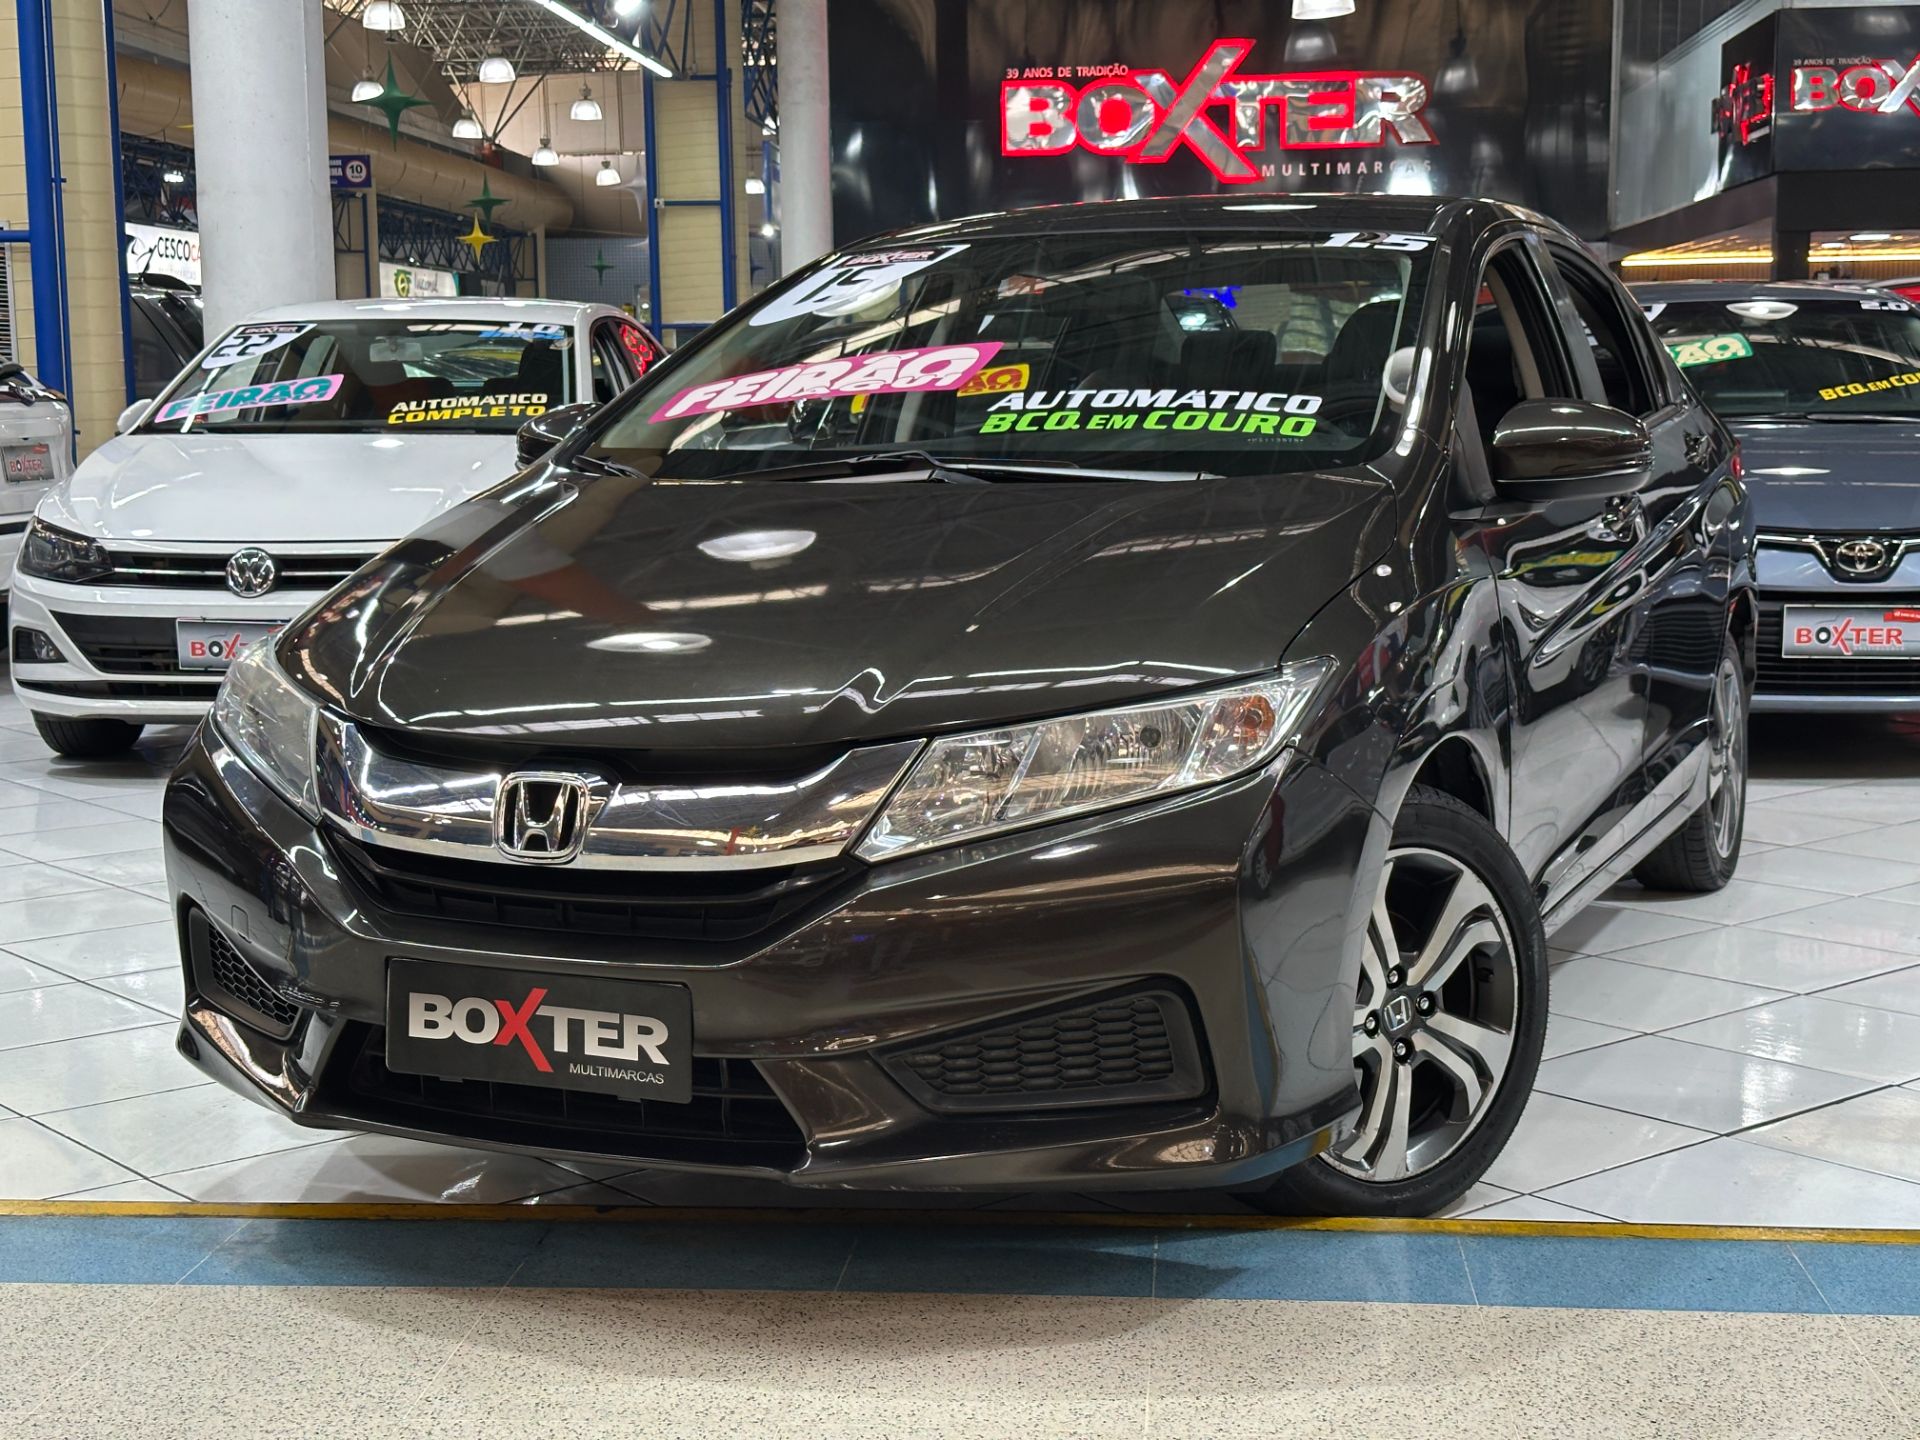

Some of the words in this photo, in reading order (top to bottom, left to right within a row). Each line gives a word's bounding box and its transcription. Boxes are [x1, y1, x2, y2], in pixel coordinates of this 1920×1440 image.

[1006, 68, 1019, 79] 39
[1023, 66, 1053, 78] ANOS
[1058, 66, 1072, 78] DE
[1076, 63, 1128, 78] TRADIÇÃO
[1002, 38, 1440, 184] BOXTER
[349, 164, 363, 175] 10
[1261, 159, 1433, 178] MULTIMARCAS
[210, 333, 279, 358] 22
[664, 347, 980, 418] FEIRÃO
[1867, 380, 1891, 391] EM
[164, 377, 333, 418] FEIRÃO
[391, 393, 548, 413] AUTOMATICO
[987, 389, 1323, 415] AUTOMATICO
[387, 405, 546, 425] COMPLETO
[1086, 414, 1135, 430] EM
[1142, 411, 1317, 437] COURO
[1795, 617, 1904, 654] BOXTER
[408, 987, 671, 1073] BOXTER
[569, 1062, 665, 1085] MULTIMARCAS
